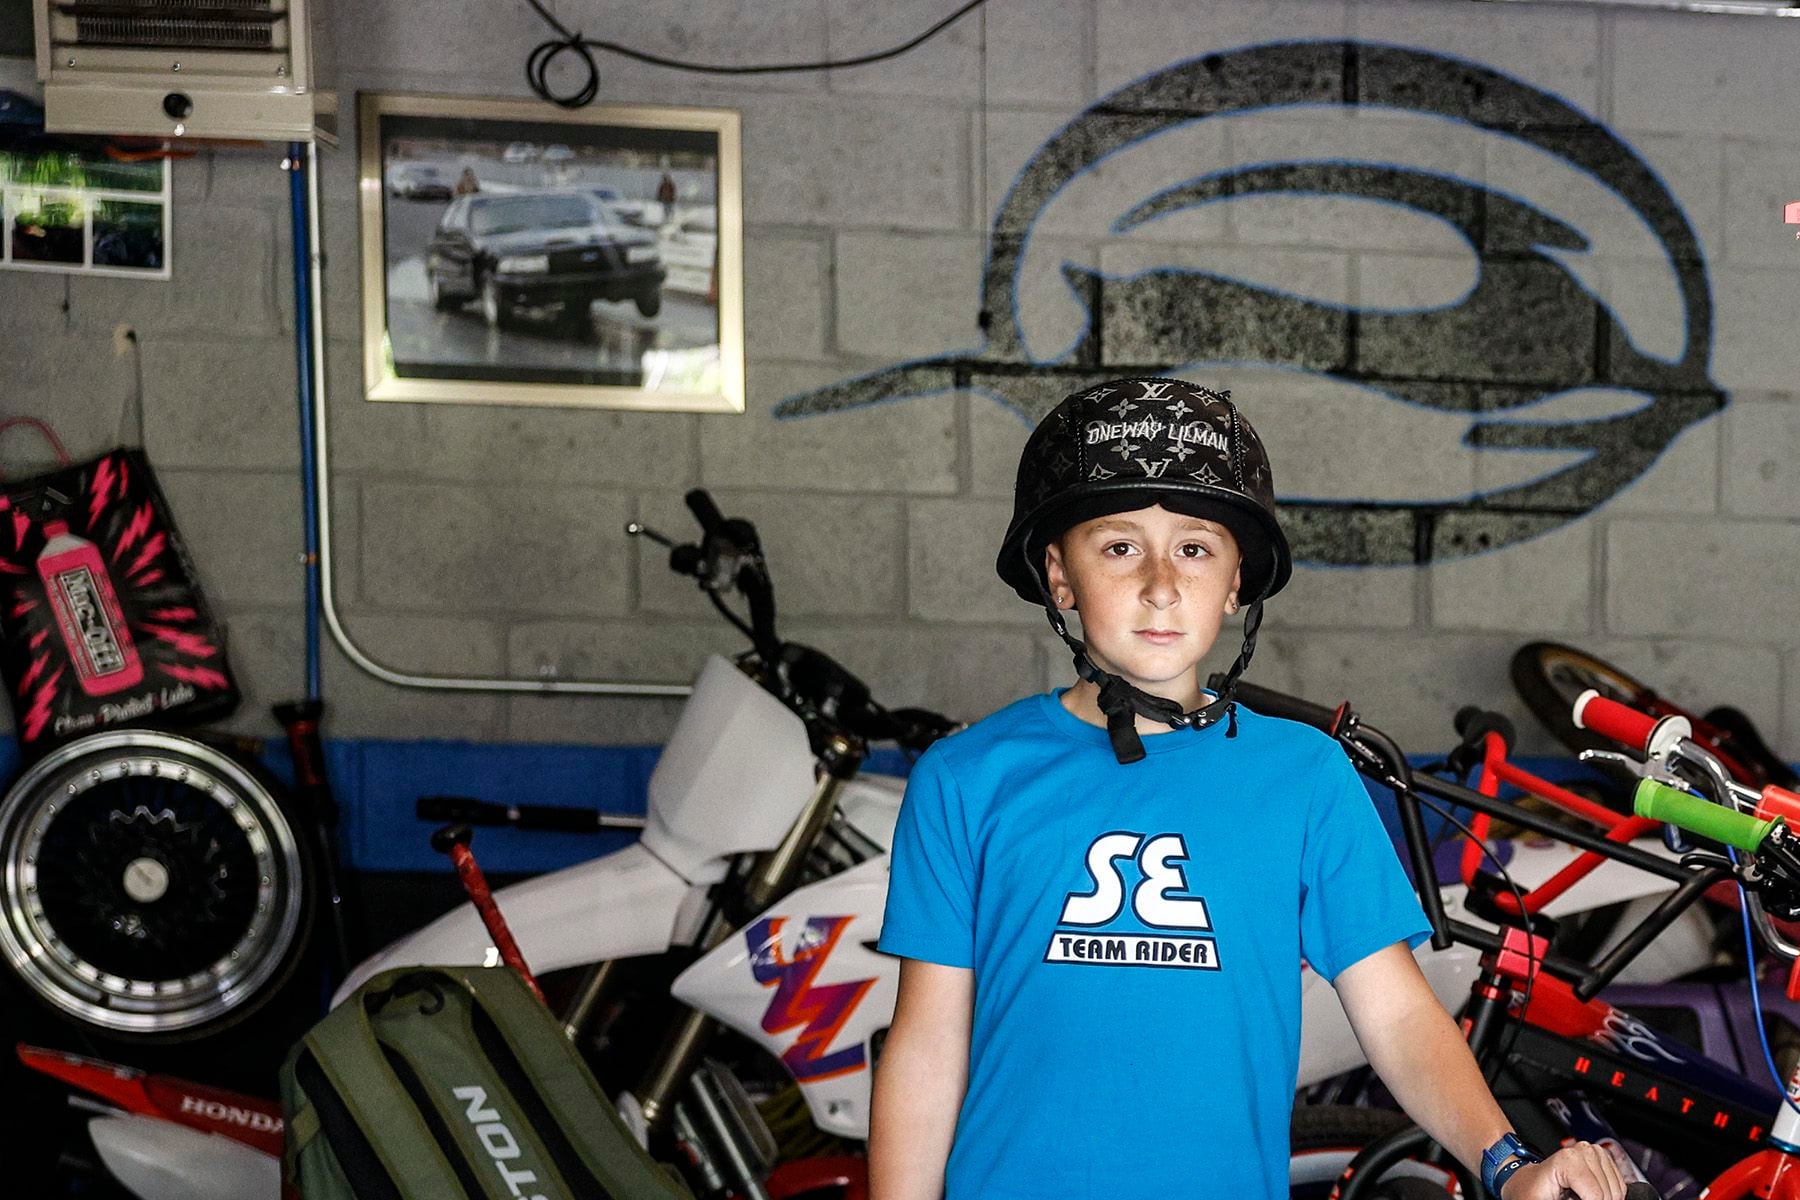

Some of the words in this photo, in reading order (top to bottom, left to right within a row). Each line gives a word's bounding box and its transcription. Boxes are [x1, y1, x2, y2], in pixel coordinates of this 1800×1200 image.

[1057, 830, 1213, 932] SE
[1059, 936, 1127, 961] TEAM
[1135, 940, 1208, 964] RIDER
